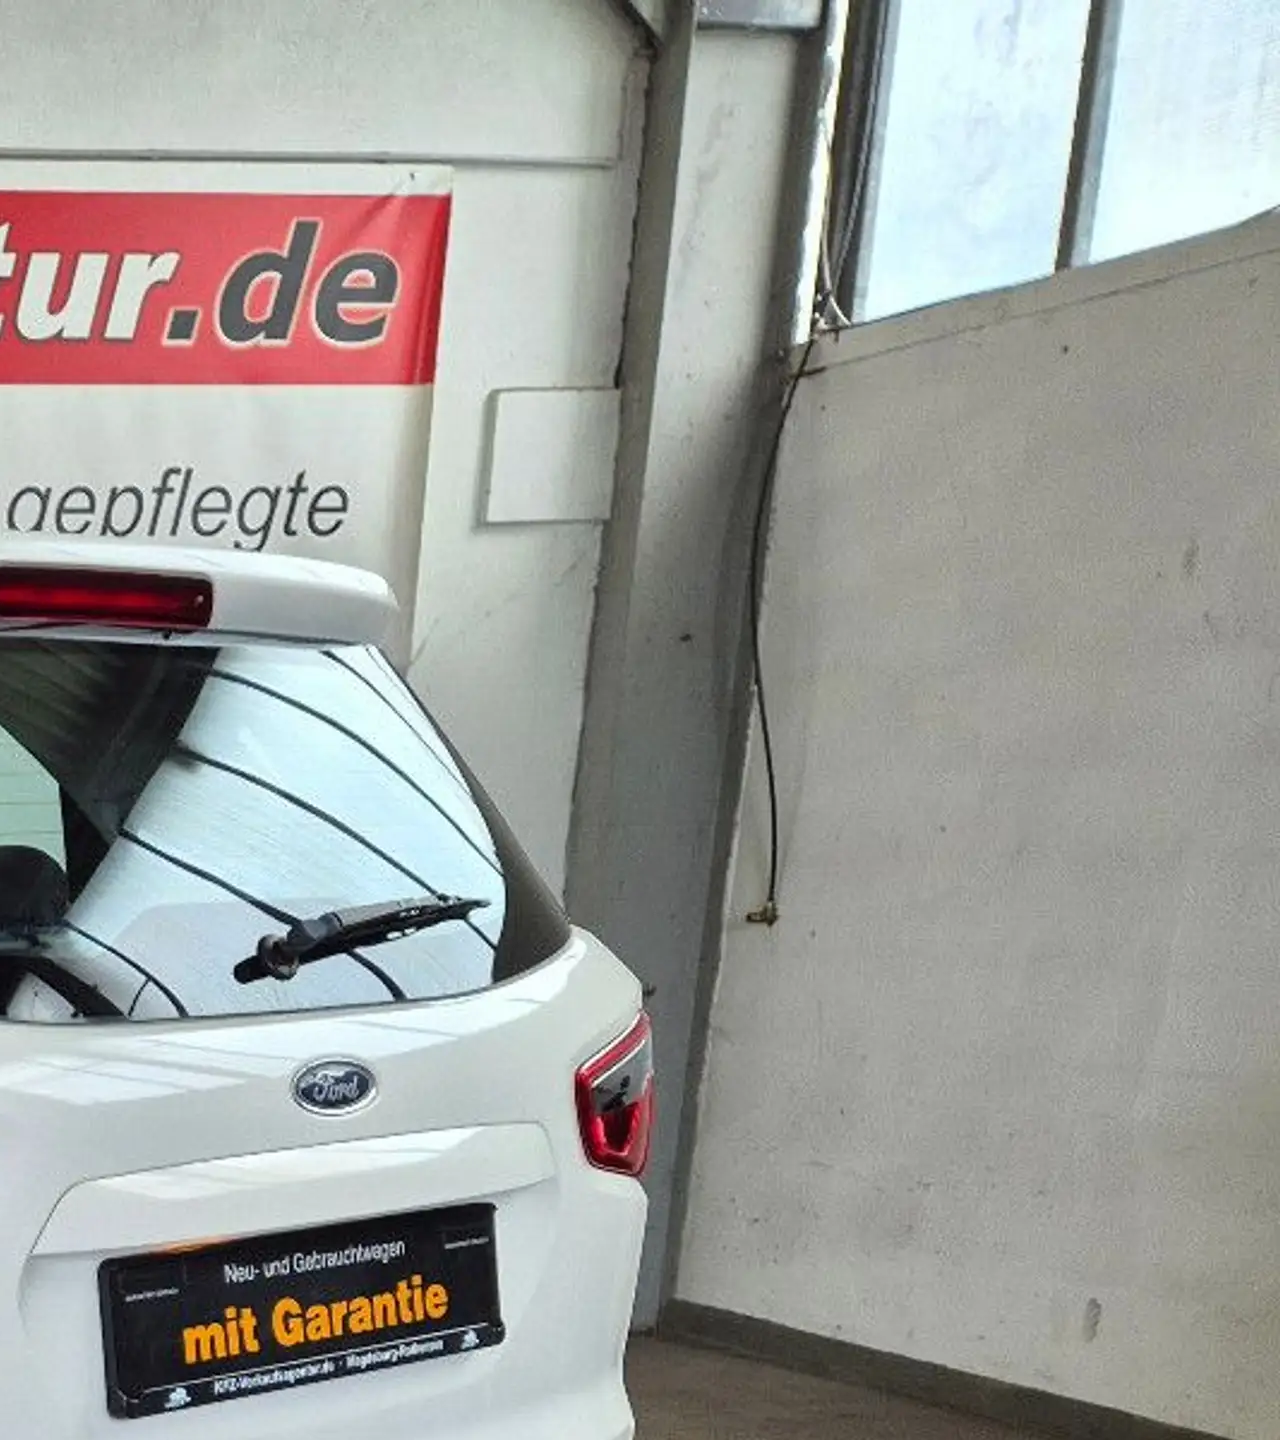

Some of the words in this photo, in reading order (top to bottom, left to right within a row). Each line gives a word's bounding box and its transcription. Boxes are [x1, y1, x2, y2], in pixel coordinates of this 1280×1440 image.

[7, 467, 349, 552] gepflegte
[224, 1262, 260, 1284] Neu-
[263, 1253, 290, 1278] und
[293, 1239, 406, 1275] Gebrauchtwagen
[183, 1305, 260, 1365] mit
[272, 1274, 449, 1347] Garantie
